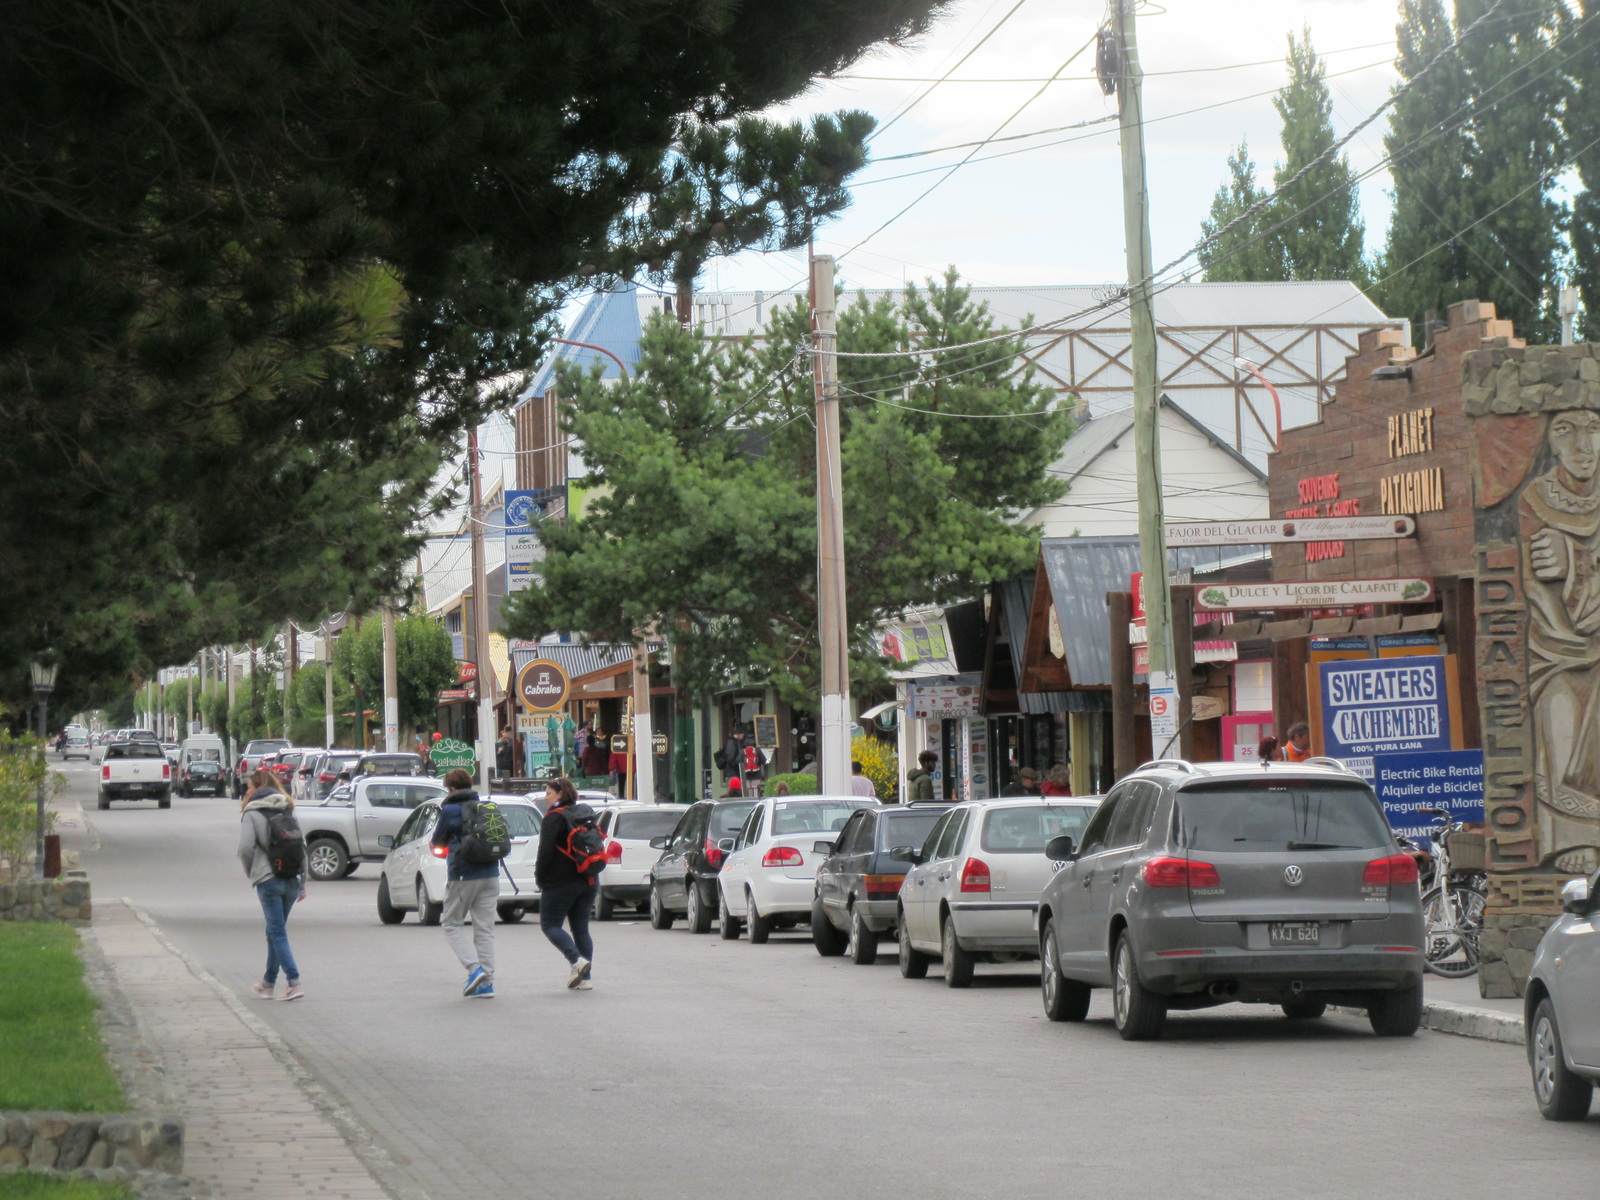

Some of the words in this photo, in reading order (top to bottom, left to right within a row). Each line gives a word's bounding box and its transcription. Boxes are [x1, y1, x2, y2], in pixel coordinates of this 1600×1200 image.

[1388, 407, 1434, 458] PLANET
[1298, 473, 1340, 505] SOUVENIRS
[1381, 467, 1444, 514] PATAGONIA
[1204, 527, 1224, 537] DEL
[1227, 524, 1277, 536] GLACIAR
[1229, 586, 1269, 598] DULCE
[1272, 586, 1280, 596] Y
[1285, 584, 1320, 596] LICOR
[1323, 584, 1338, 594] DE
[1340, 582, 1400, 595] CALAFATE
[1295, 596, 1336, 604] Premium
[525, 684, 561, 695] Cabrales
[1332, 668, 1435, 703] SWEATERS
[931, 709, 968, 719] TABACCO
[1340, 706, 1437, 741] CACHEMERE
[1241, 747, 1253, 756] 25
[1352, 745, 1374, 753] 100%
[1375, 743, 1398, 751] PURA
[1400, 742, 1422, 750] LANA
[1381, 769, 1421, 780] Electric
[1423, 767, 1446, 778] Bike
[1448, 764, 1483, 776] Rental
[1382, 785, 1424, 798] Alquiler
[1427, 783, 1441, 793] de
[1444, 781, 1484, 793] Biciclet
[1383, 800, 1433, 814] Pregunte
[1435, 801, 1449, 809] en
[1271, 928, 1293, 941] KXJ
[1298, 928, 1318, 941] 620
